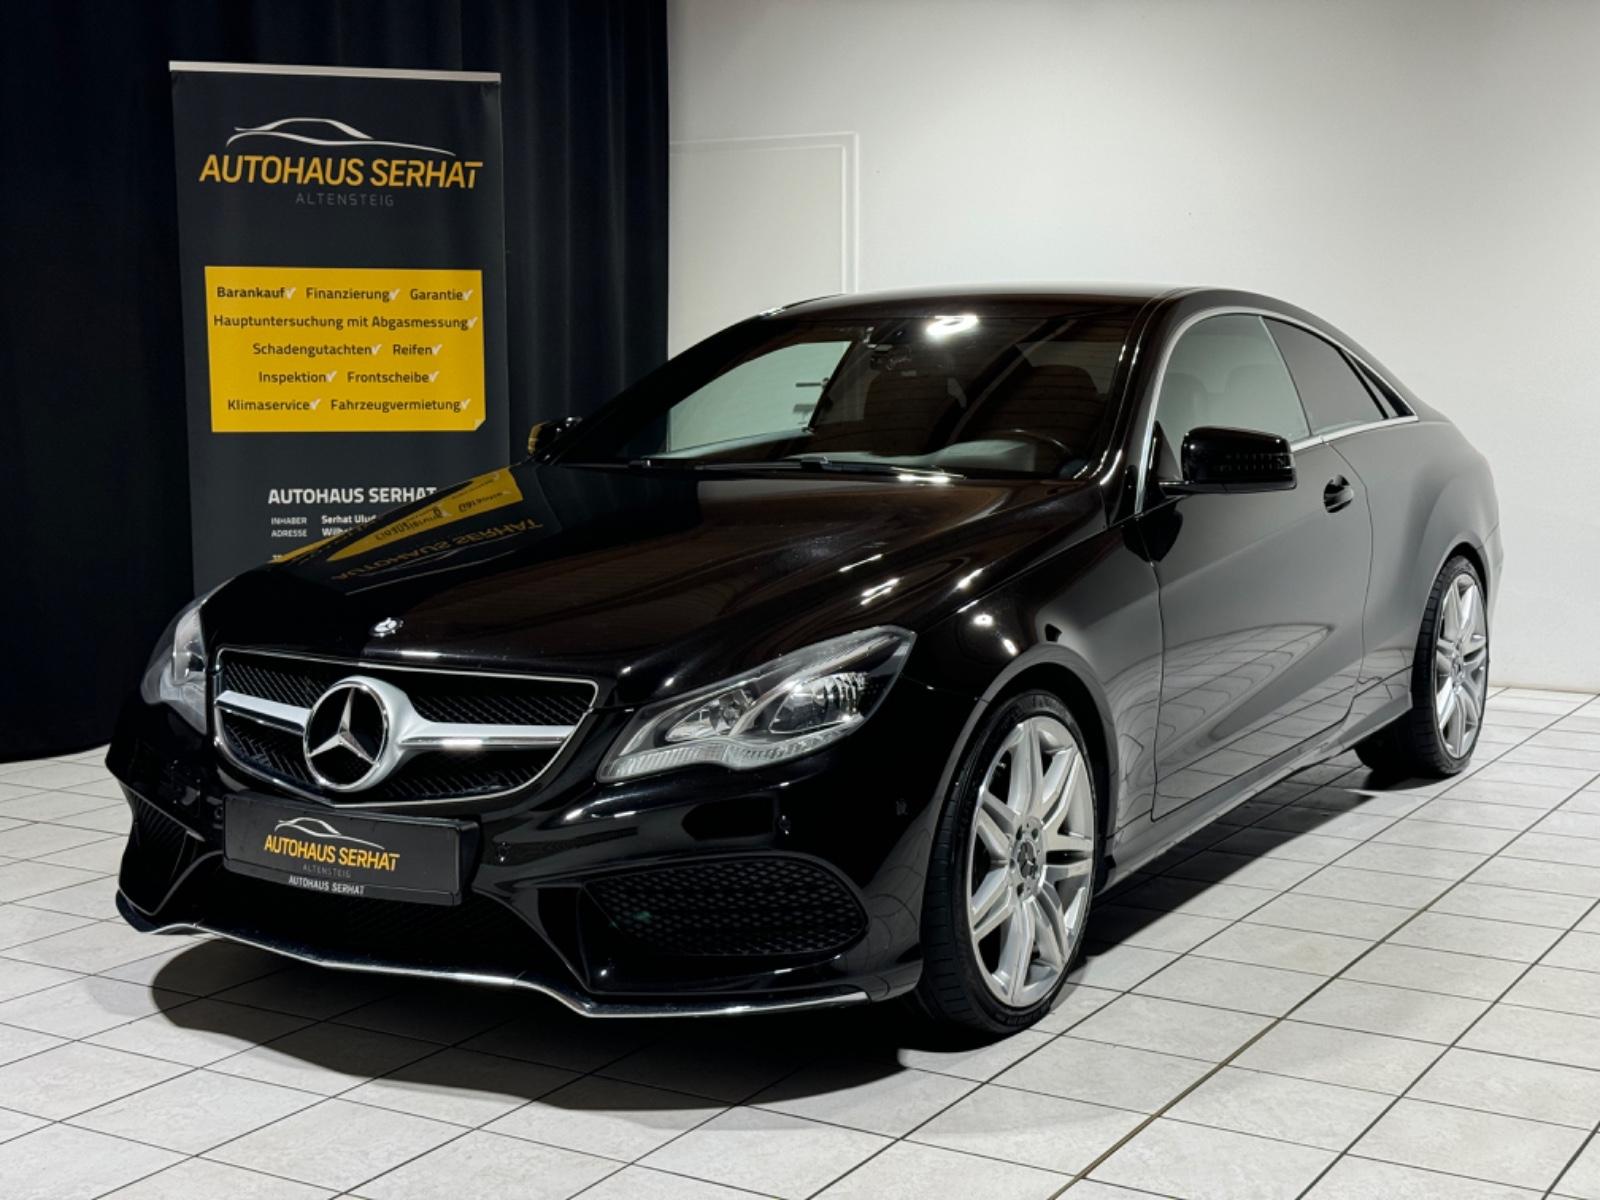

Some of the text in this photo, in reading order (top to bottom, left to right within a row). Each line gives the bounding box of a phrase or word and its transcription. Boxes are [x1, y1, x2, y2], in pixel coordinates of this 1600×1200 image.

[199, 154, 483, 189] AUTOHAUS SERHAT
[295, 192, 394, 207] ALTENSTEIG
[216, 287, 464, 302] Barankauf Finanzierung Garantie
[213, 314, 469, 331] Hauptuntersuchung mit Abgasmessung
[252, 342, 433, 359] Schadengutachten Reifen
[258, 370, 430, 385] Inspektion Frontscheibe
[227, 398, 461, 413] Klimaservice Fahrzeugvermietung
[267, 488, 364, 505] AUTOHAUS
[368, 486, 438, 504] SERHAT
[271, 516, 307, 525] INHABER
[321, 514, 352, 525] Serhat
[271, 529, 307, 537] ADRESSE
[264, 834, 400, 871] AUTOHAUS SERHAT
[288, 876, 365, 895] AUTOHAUS SERHAT
